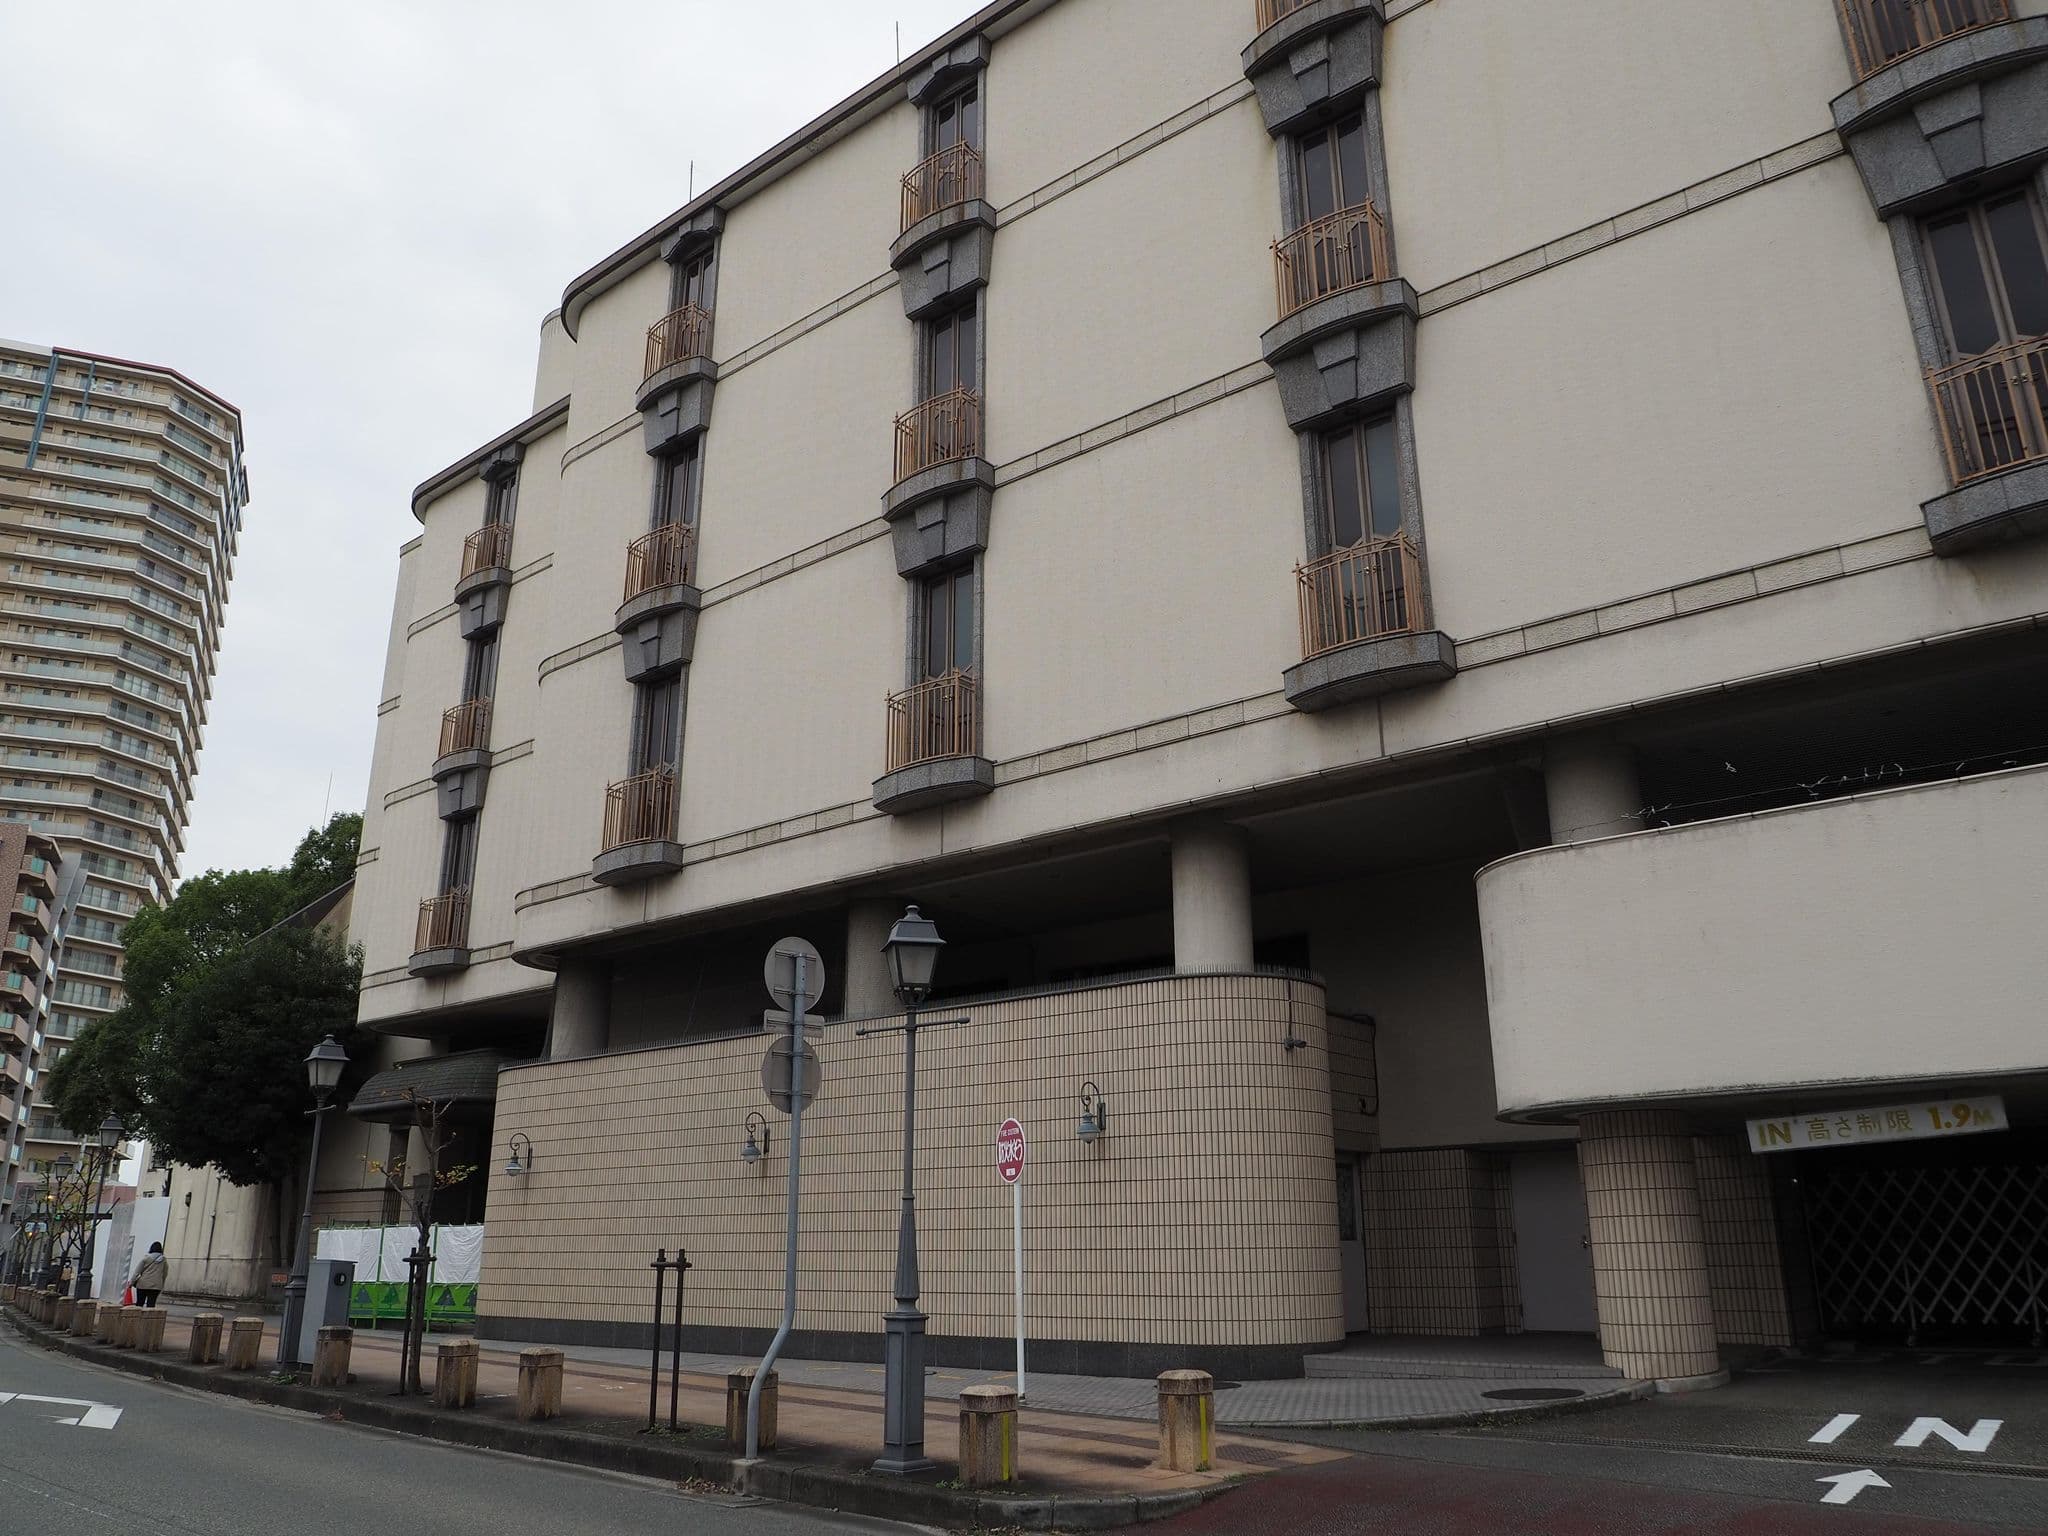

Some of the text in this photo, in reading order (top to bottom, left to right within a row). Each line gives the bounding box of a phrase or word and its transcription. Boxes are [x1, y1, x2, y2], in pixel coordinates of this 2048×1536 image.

[1757, 1120, 1793, 1147] IN
[1806, 1109, 1913, 1143] 高さ制限
[1808, 1413, 2004, 1452] IN
